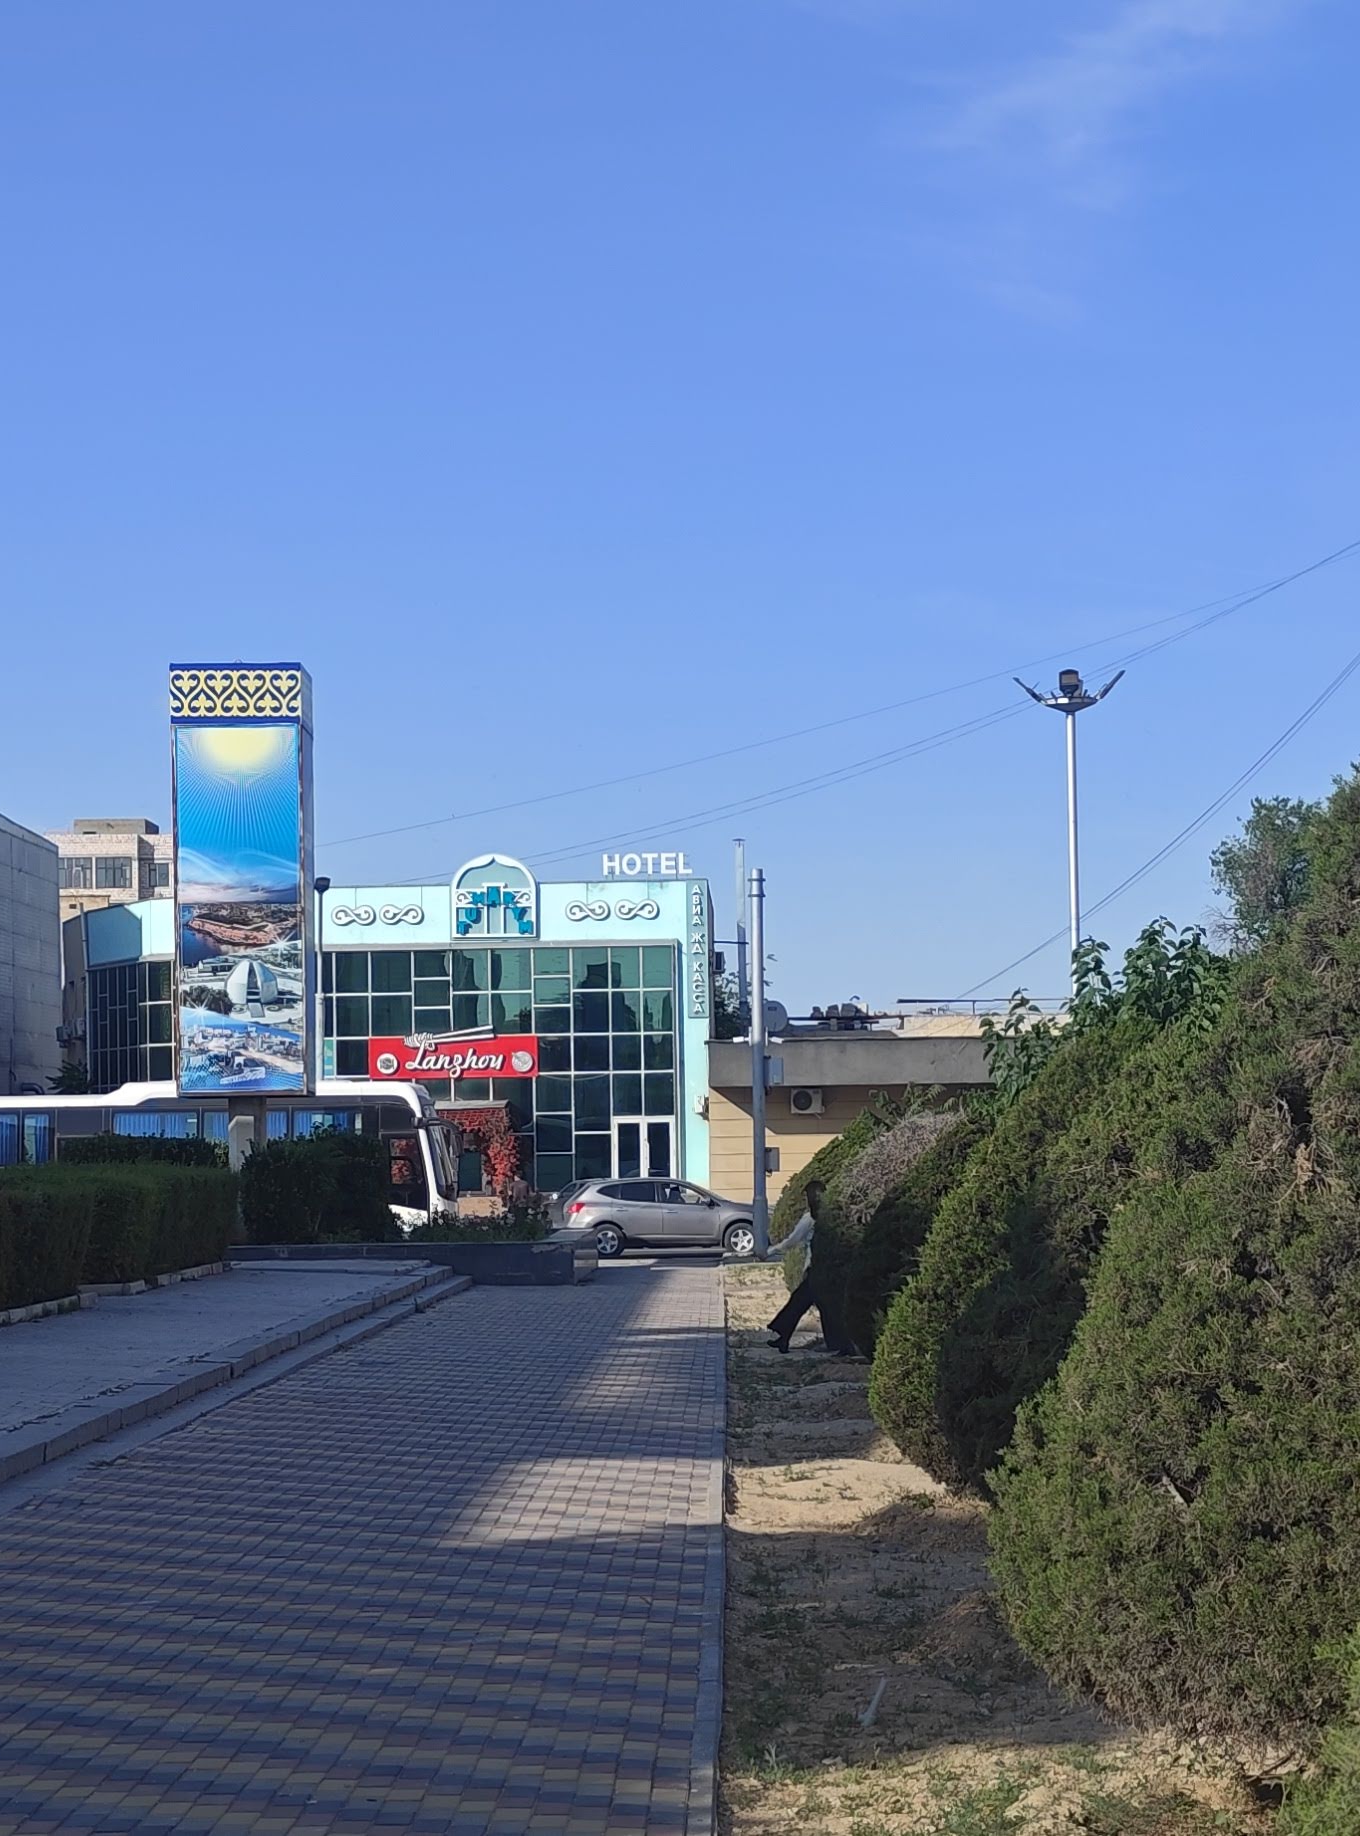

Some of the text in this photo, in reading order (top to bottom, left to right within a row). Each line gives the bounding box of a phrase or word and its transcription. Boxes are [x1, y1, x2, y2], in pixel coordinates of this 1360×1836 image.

[602, 851, 693, 877] HOTEL
[691, 884, 705, 1014] АВИА ЖД КАССА
[405, 1041, 504, 1078] Lanzhou
